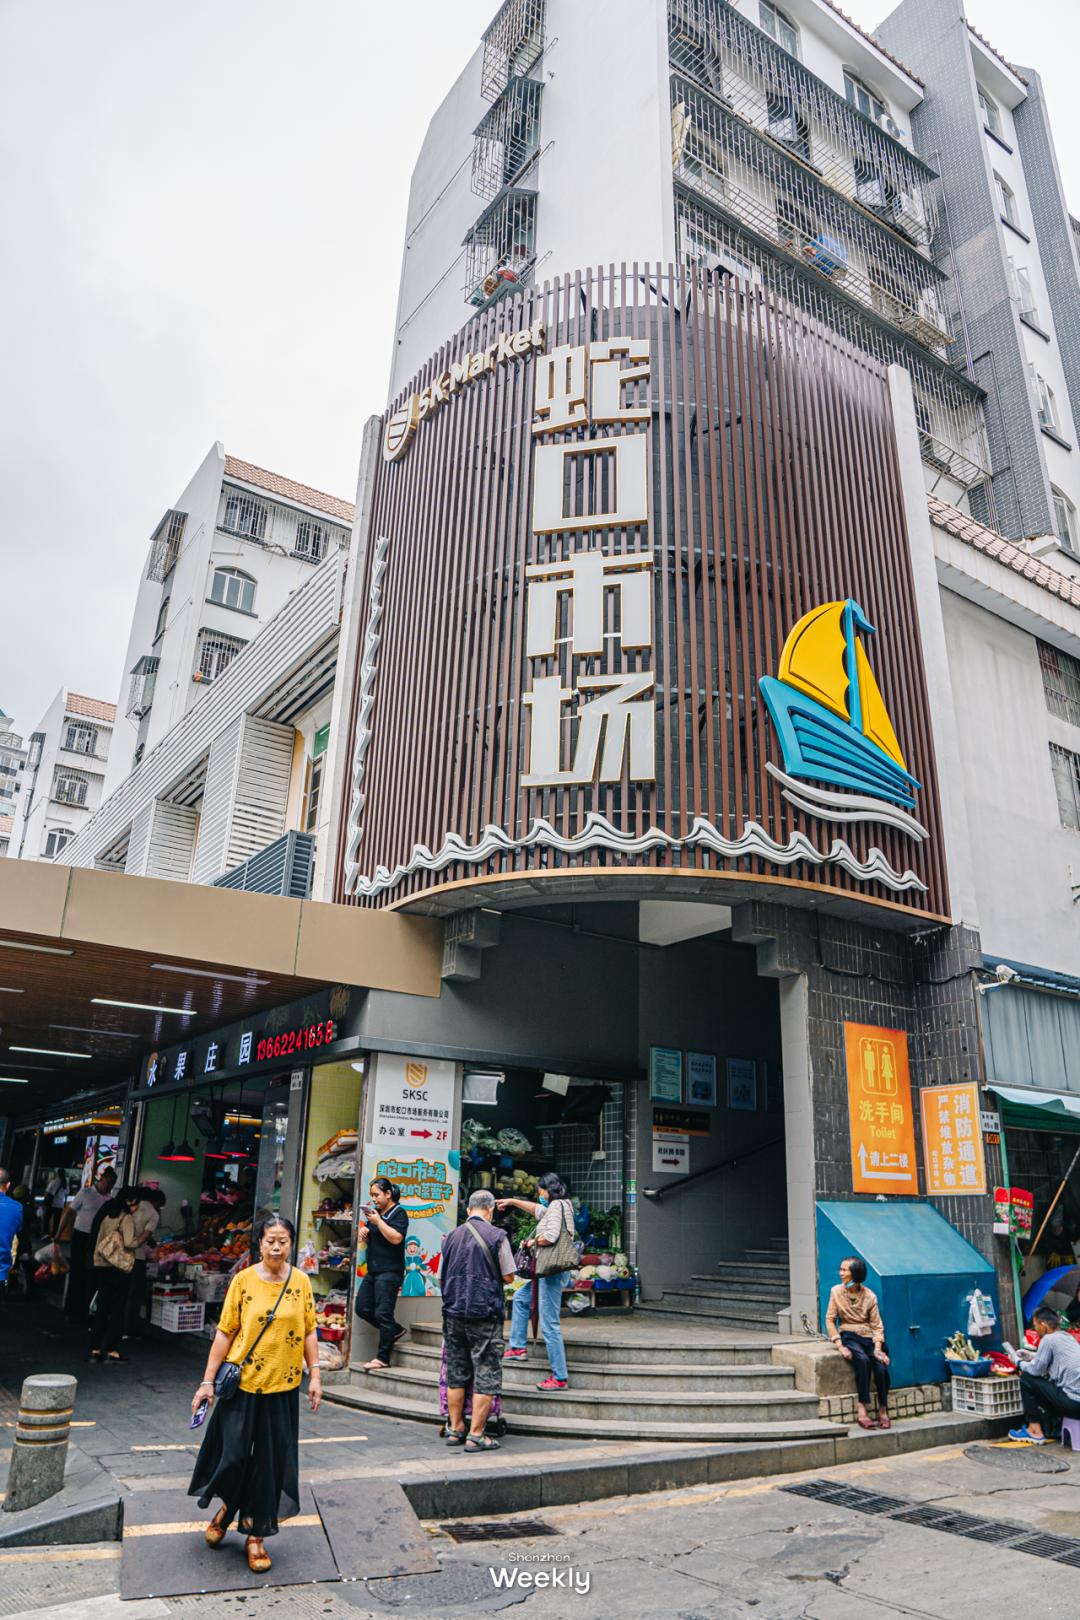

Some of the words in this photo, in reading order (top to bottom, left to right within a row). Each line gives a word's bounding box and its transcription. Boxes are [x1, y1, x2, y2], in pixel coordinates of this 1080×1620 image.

[521, 337, 655, 788] 蛇口市场
[147, 1032, 253, 1088] 水果庄园
[402, 1089, 428, 1101] SKSC
[859, 1100, 904, 1125] 洗手间
[379, 1125, 405, 1137] 办公室
[436, 1130, 448, 1140] 2F
[869, 1125, 896, 1139] Toilet
[938, 1094, 956, 1186] 严禁堆放杂物
[954, 1092, 977, 1186] 消防通道
[377, 1160, 446, 1183] 蛇口市场
[870, 1152, 909, 1168] 请上二楼
